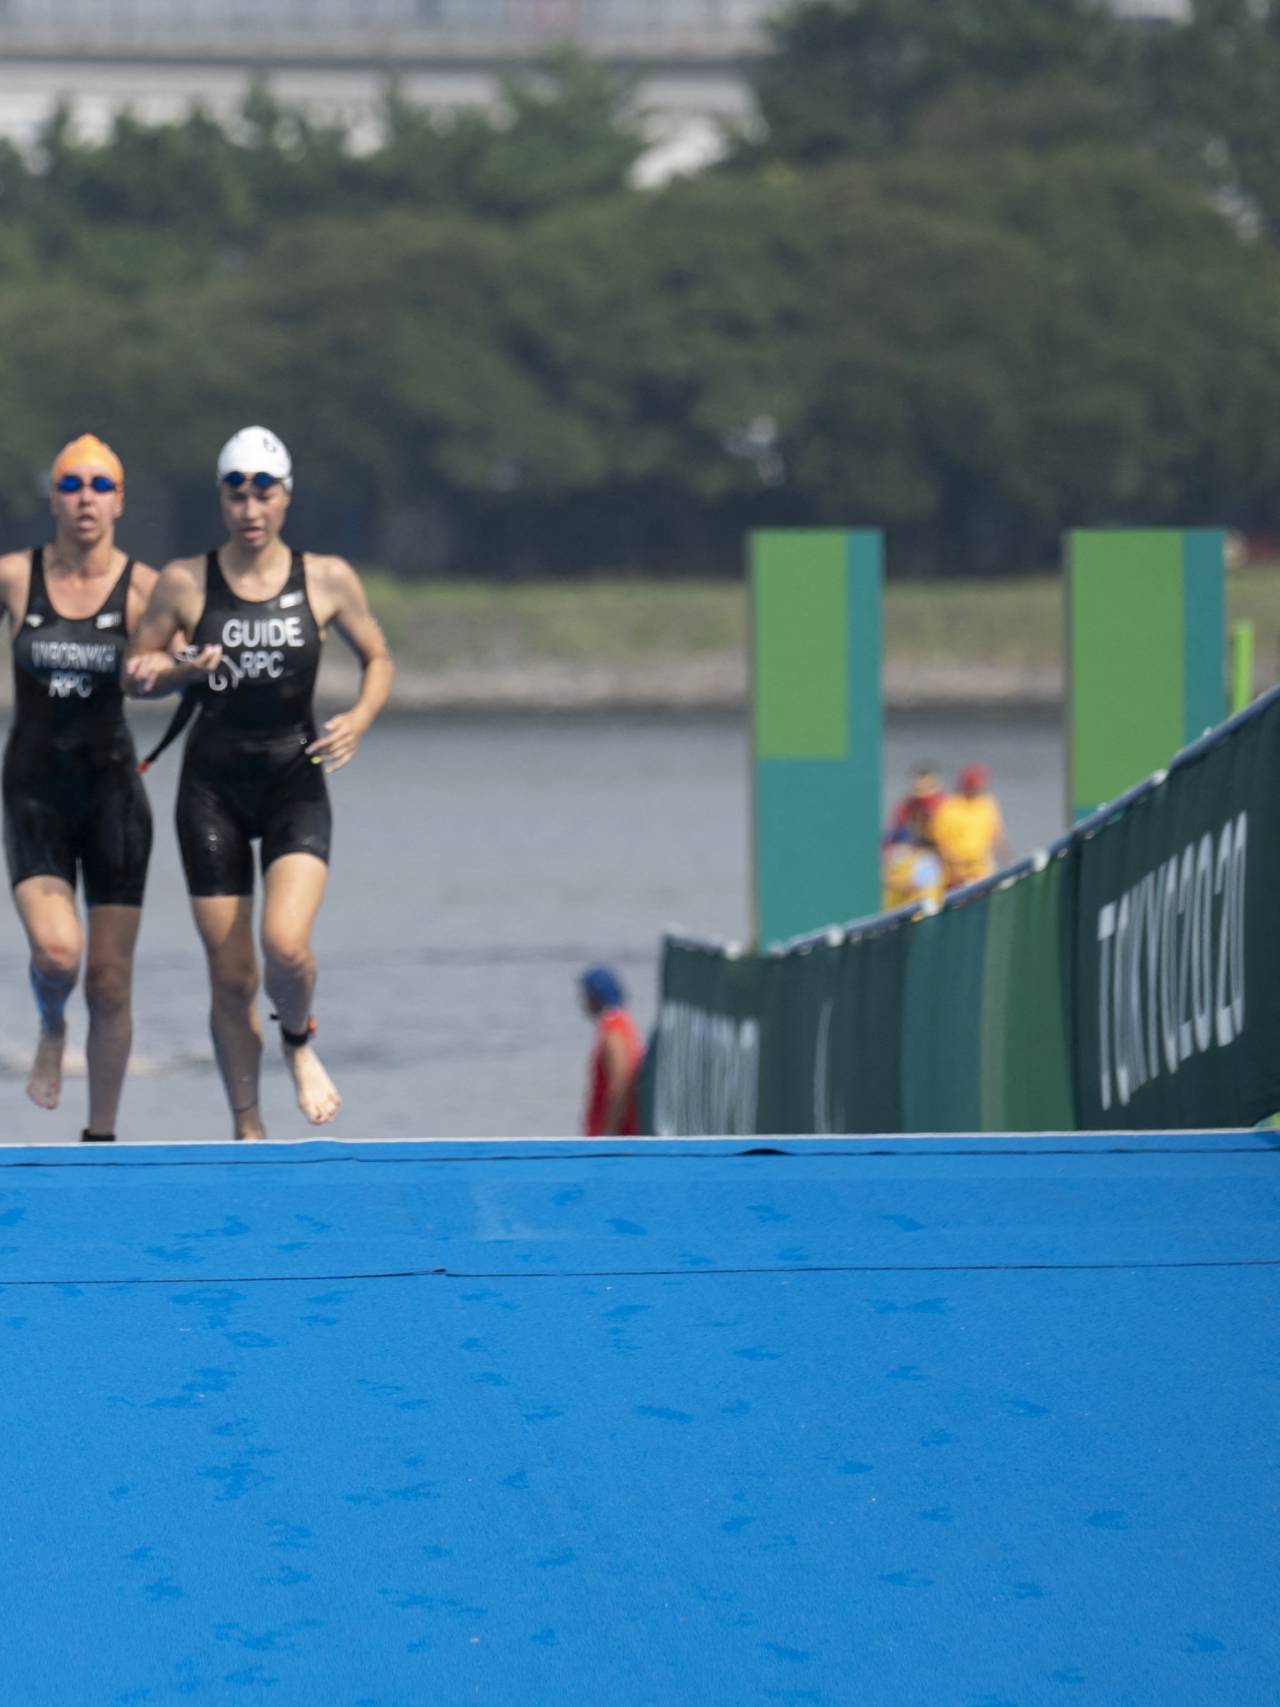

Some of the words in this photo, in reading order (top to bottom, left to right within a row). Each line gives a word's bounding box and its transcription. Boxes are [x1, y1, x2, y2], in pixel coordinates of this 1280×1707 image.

[222, 616, 305, 648] GUIDE
[240, 651, 284, 678] RPC
[48, 671, 93, 698] RPC
